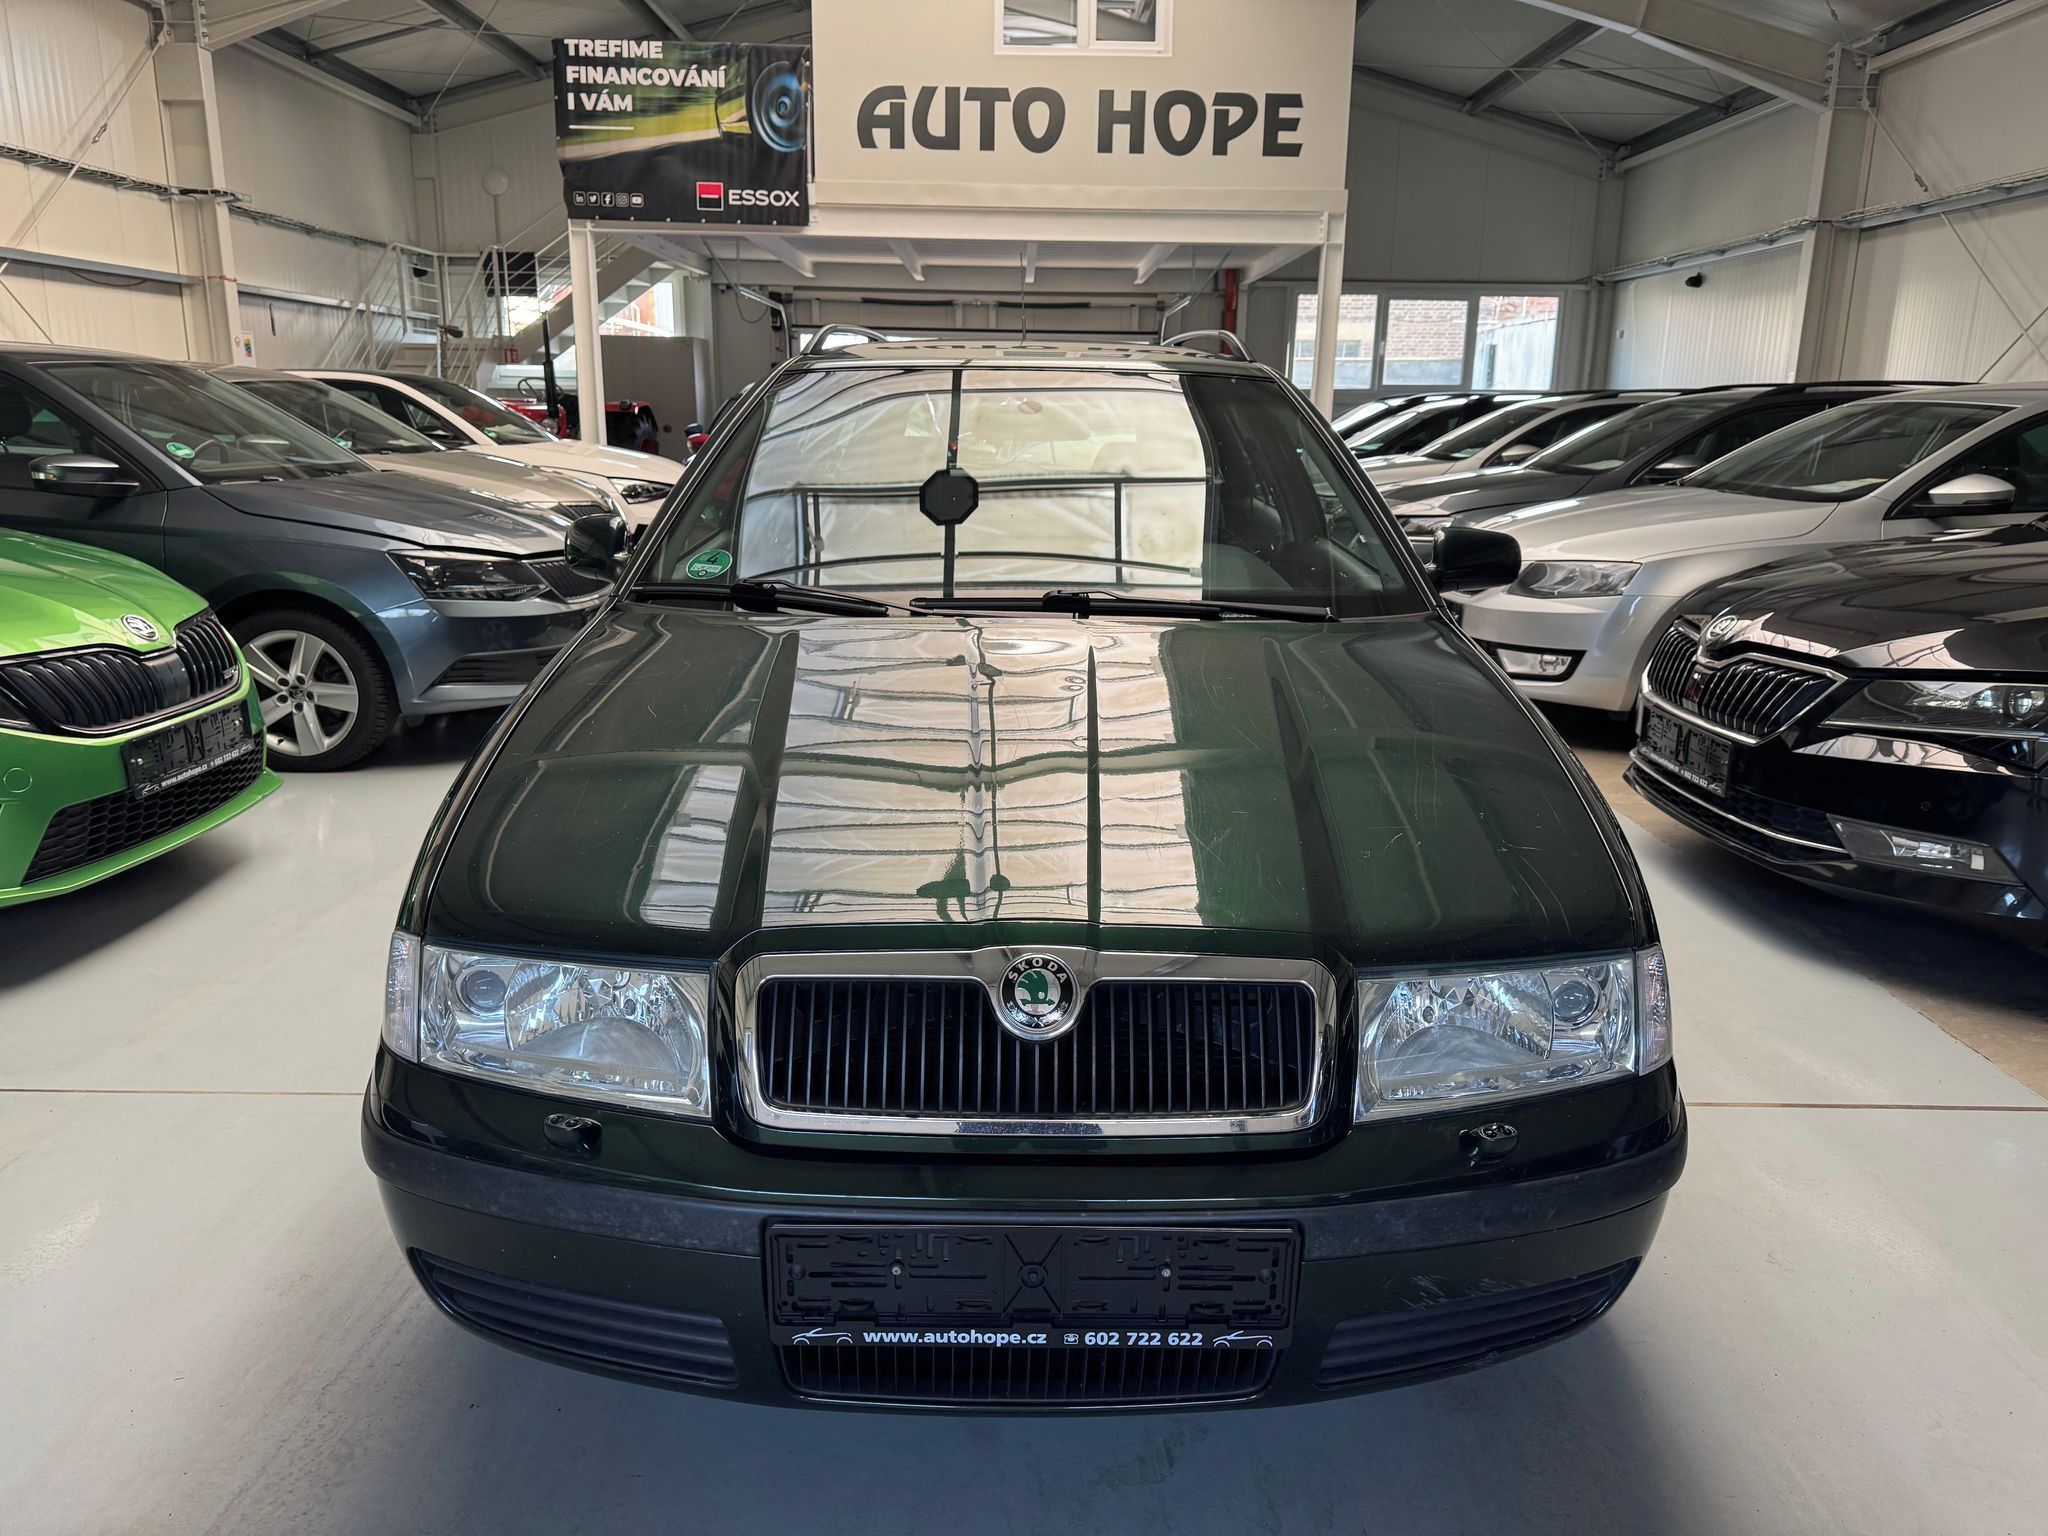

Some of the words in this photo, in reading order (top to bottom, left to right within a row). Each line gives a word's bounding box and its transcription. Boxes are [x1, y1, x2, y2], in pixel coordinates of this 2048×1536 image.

[564, 39, 663, 59] TREFIME
[566, 65, 727, 88] FINANCOVÁNÍ
[567, 92, 575, 110] I
[580, 88, 633, 112] VÁM
[857, 85, 1066, 153] AUTO
[1097, 89, 1304, 157] HOPE
[728, 189, 800, 207] ESSOX
[863, 1329, 1047, 1347] www.autohope.cz
[1084, 1332, 1120, 1346] 602
[1126, 1332, 1162, 1346] 722
[1167, 1332, 1203, 1346] 622
